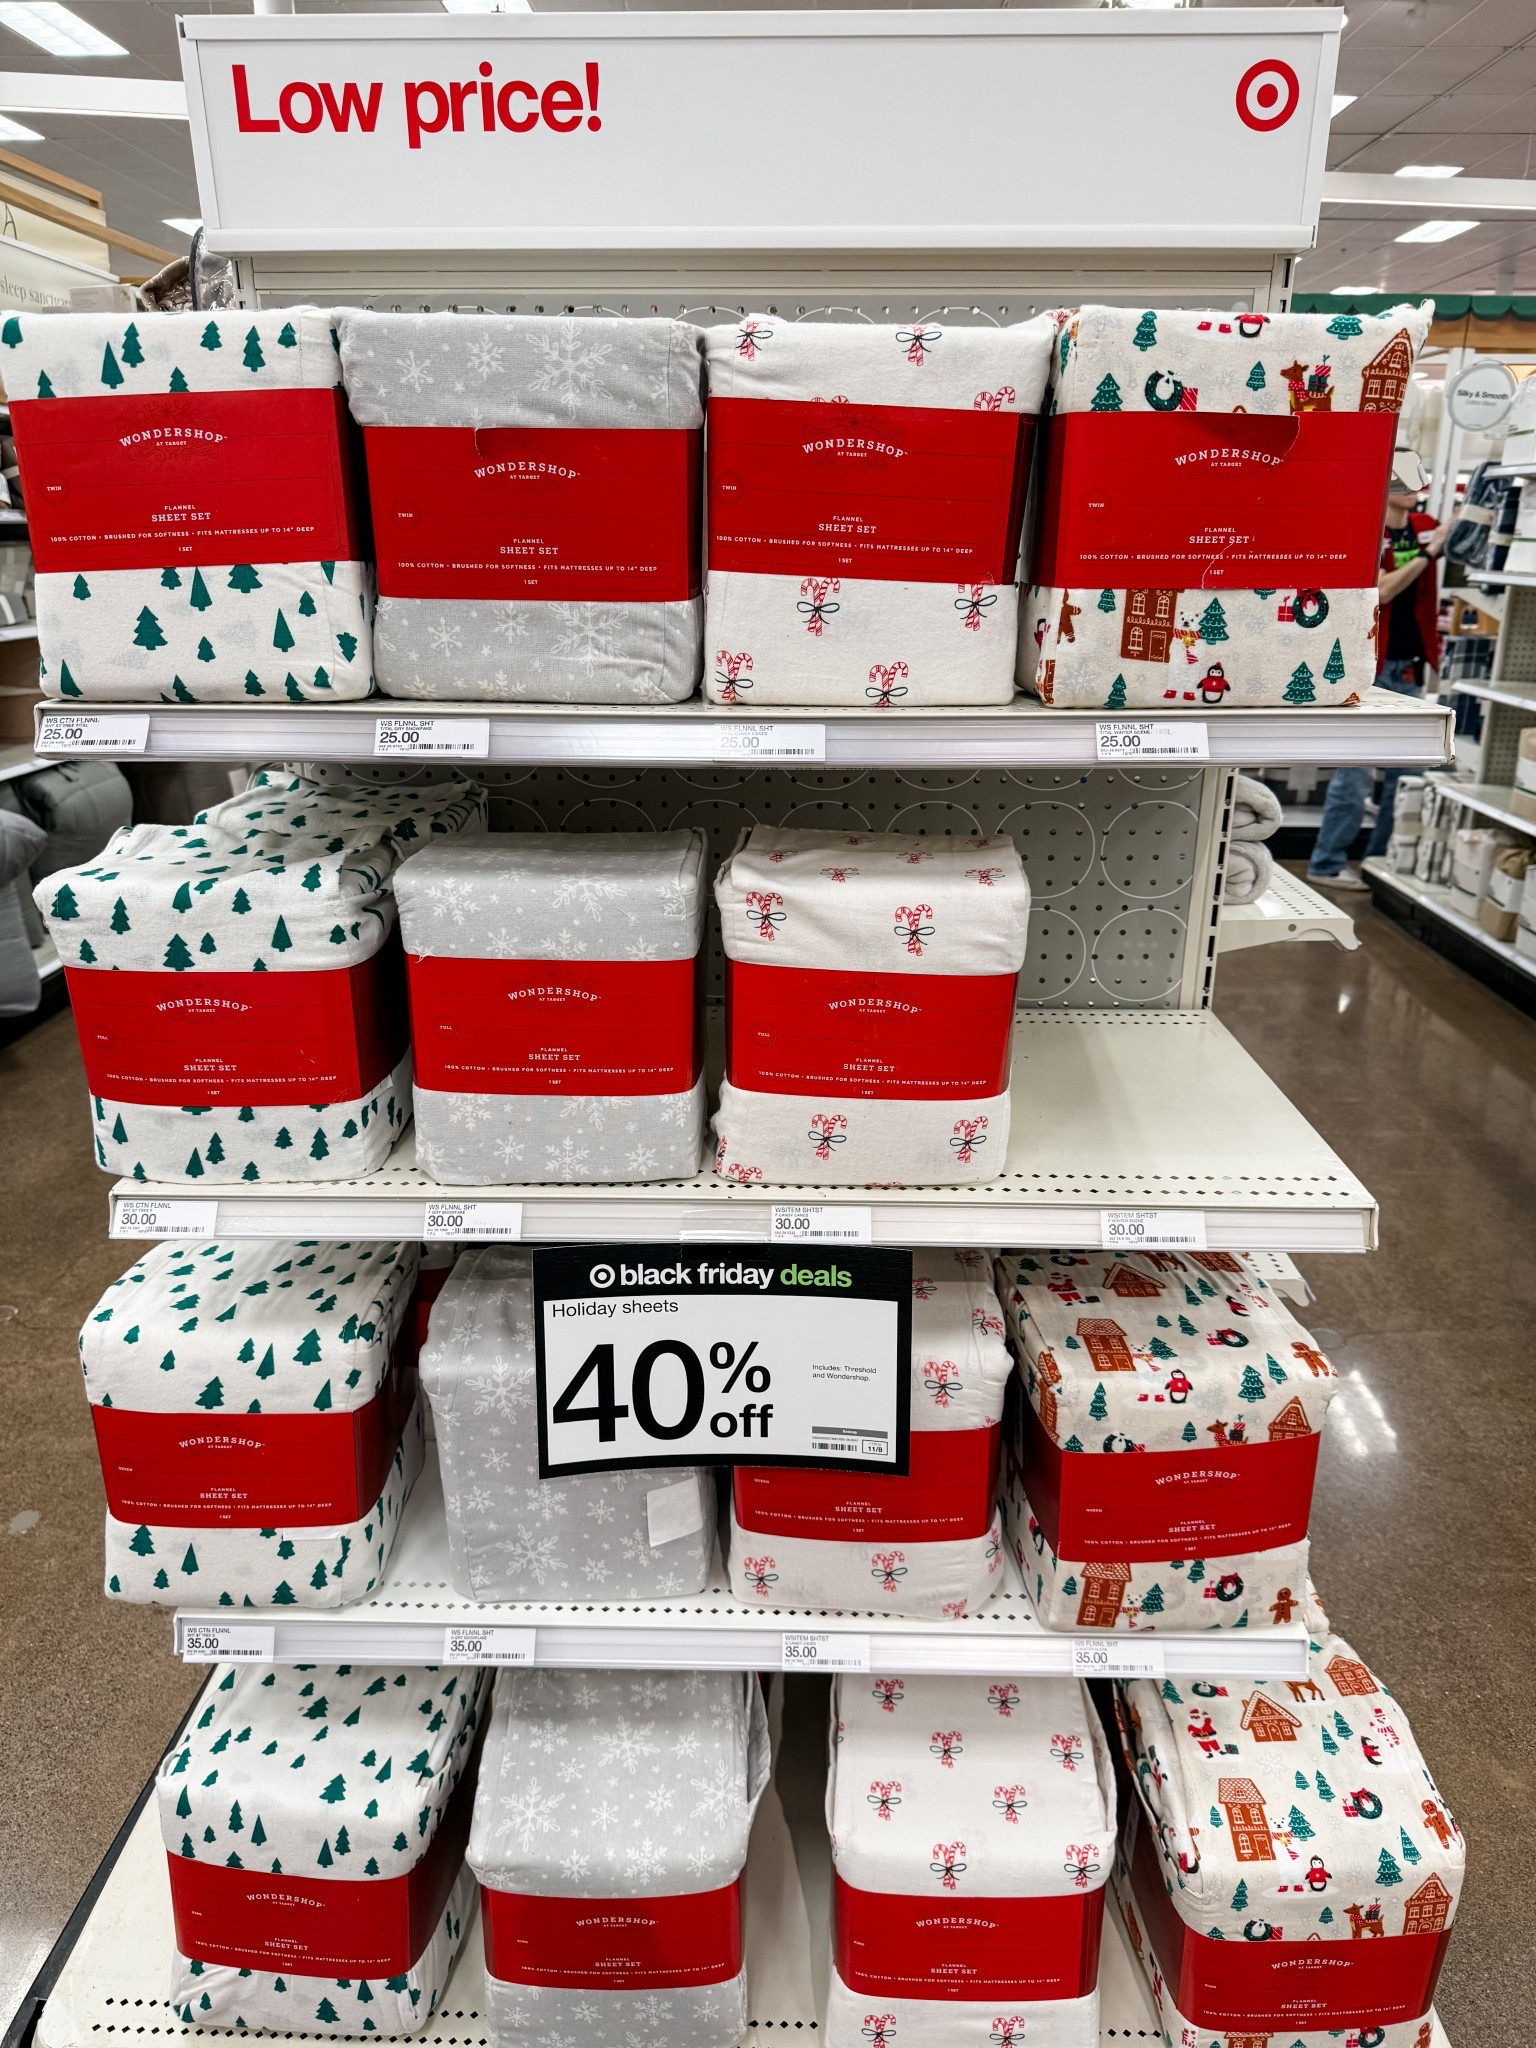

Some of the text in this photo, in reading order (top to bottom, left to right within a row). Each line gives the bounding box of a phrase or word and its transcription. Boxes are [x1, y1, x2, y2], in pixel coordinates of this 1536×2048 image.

[232, 61, 601, 149] Low price!
[0, 275, 27, 302] sleep
[119, 428, 224, 447] WONDERSHOP
[802, 439, 904, 458] WONDERSHOP
[1175, 448, 1281, 466] WONDERSHOP
[474, 462, 576, 479] WONDERSHOP
[152, 514, 186, 522] SHEET
[819, 524, 876, 533] SHEET SET
[1229, 536, 1250, 544] SET
[43, 728, 84, 741] 25.00
[380, 732, 419, 743] 25.00
[721, 736, 759, 748] 25.00
[1101, 735, 1140, 747] 25.00
[508, 987, 598, 1002] WONDERSHOP
[156, 998, 249, 1012] WONDERSHOP
[828, 998, 918, 1014] WONDERSHOP
[122, 1213, 156, 1225] 30.00
[428, 1215, 463, 1227] 30.00
[776, 1218, 810, 1229] 30.00
[1109, 1224, 1144, 1235] 30.00
[621, 1262, 852, 1289] black friday deals
[552, 1300, 678, 1319] Holiday sheets
[844, 1366, 877, 1374] Threshold
[827, 1373, 870, 1381] Wondershop.
[709, 1403, 773, 1438] off
[179, 1436, 262, 1449] WONDERSHOP
[1155, 1470, 1236, 1486] WONDERSHOP
[1169, 1524, 1197, 1532] SHEET
[188, 1638, 218, 1648] 35.00
[451, 1640, 482, 1652] 35.00
[786, 1646, 816, 1657] 35.00
[1076, 1652, 1107, 1663] 35.00
[247, 1893, 322, 1908] WONDERSHOP
[576, 1917, 656, 1926] WONDERSHOP
[916, 1917, 996, 1929] WONDERSHOP
[1271, 1958, 1351, 1970] WONDERSHOP
